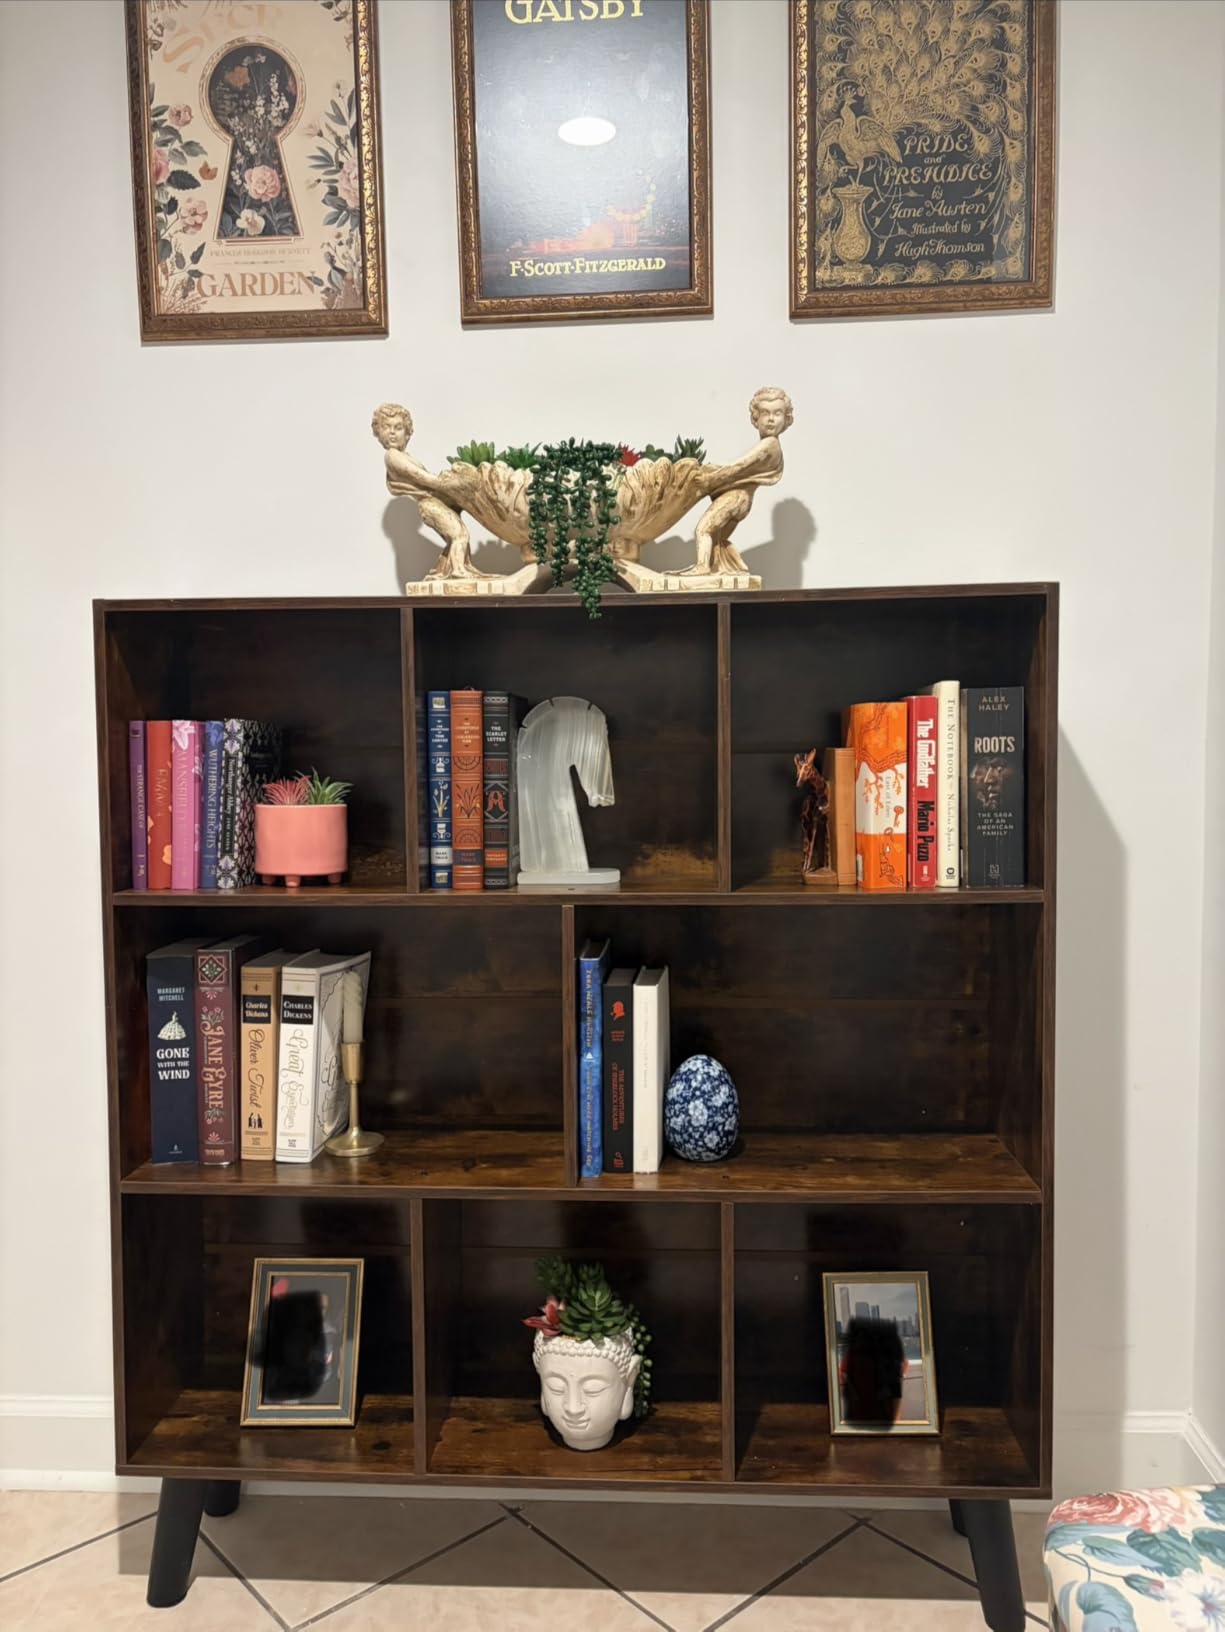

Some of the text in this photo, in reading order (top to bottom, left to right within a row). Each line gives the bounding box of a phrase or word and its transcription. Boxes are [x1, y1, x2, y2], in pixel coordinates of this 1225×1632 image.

[904, 133, 968, 156] PRIDE
[923, 154, 946, 164] and
[882, 163, 992, 186] PREJUDICE
[931, 185, 944, 200] by
[889, 200, 988, 219] Jane Austen
[910, 221, 960, 235] Illustrated
[894, 239, 985, 260] Hugh Thomson
[197, 271, 316, 298] GARDEN
[978, 703, 1009, 711] HALEY
[946, 698, 956, 780] THE NOTEBOOK
[974, 736, 1015, 753] ROOTS
[916, 719, 936, 789] The Godfather
[206, 749, 218, 848] WUTHERING HEIGHTS
[916, 801, 935, 832] Mario
[916, 835, 935, 862] Puzo
[157, 987, 185, 995] MARGARET
[156, 1047, 190, 1060] GONE
[200, 1021, 225, 1065] JANE
[158, 1069, 191, 1081] WIND
[248, 1029, 266, 1109] Oliver Twist
[200, 1066, 227, 1109] EYRE
